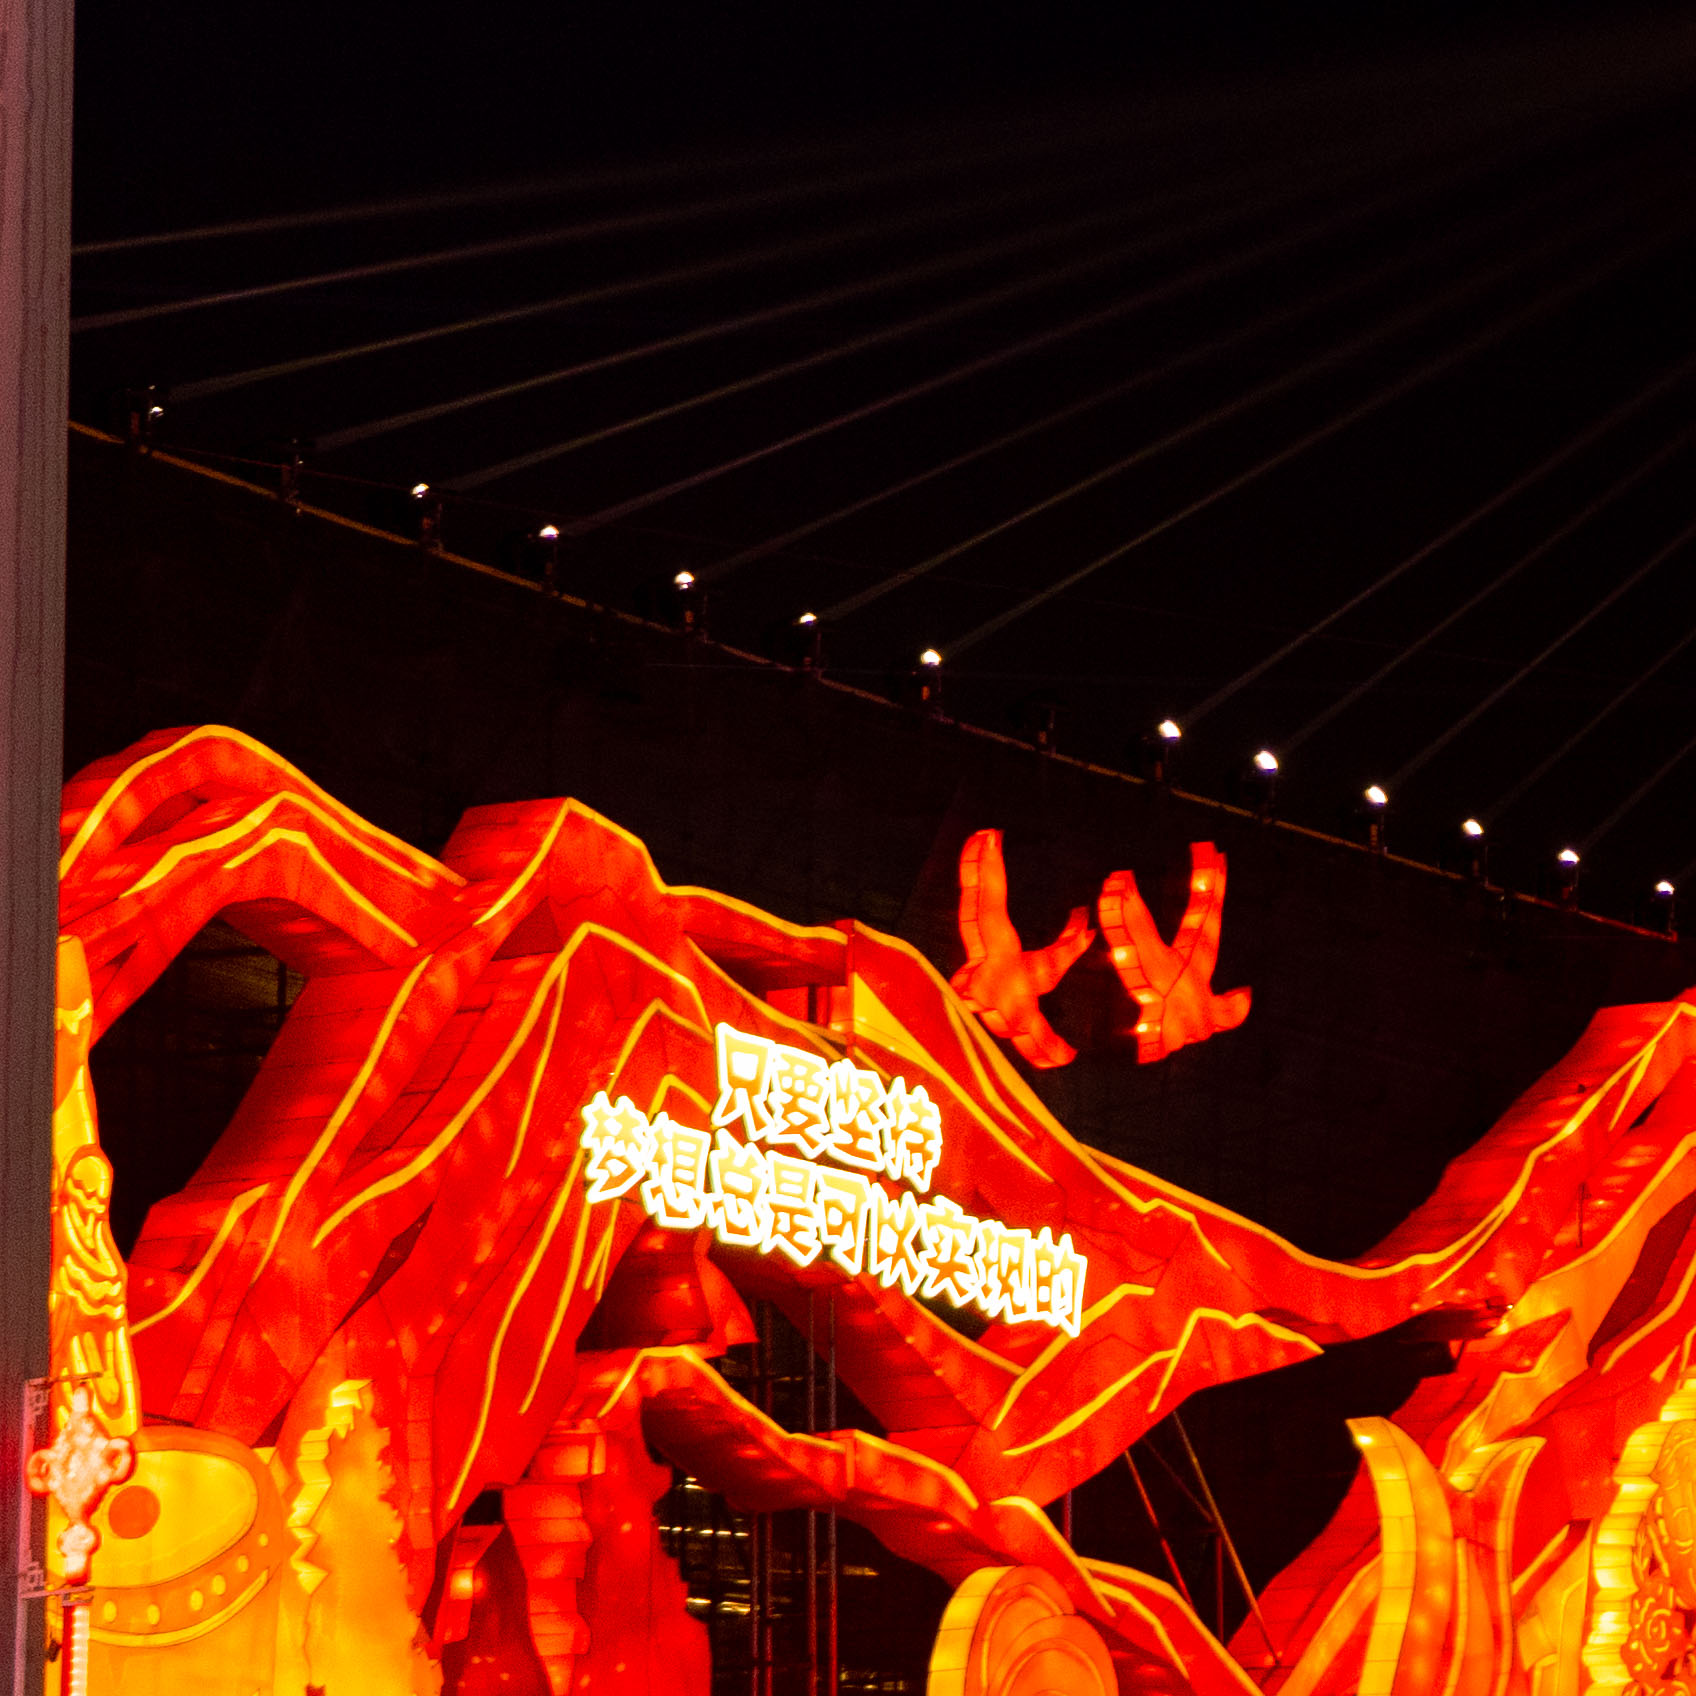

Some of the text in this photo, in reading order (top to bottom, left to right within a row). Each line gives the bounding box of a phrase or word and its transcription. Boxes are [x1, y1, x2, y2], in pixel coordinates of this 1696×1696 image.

[711, 1022, 942, 1192] 只要坚持
[580, 1091, 1088, 1338] 梦想总是可以实现的
